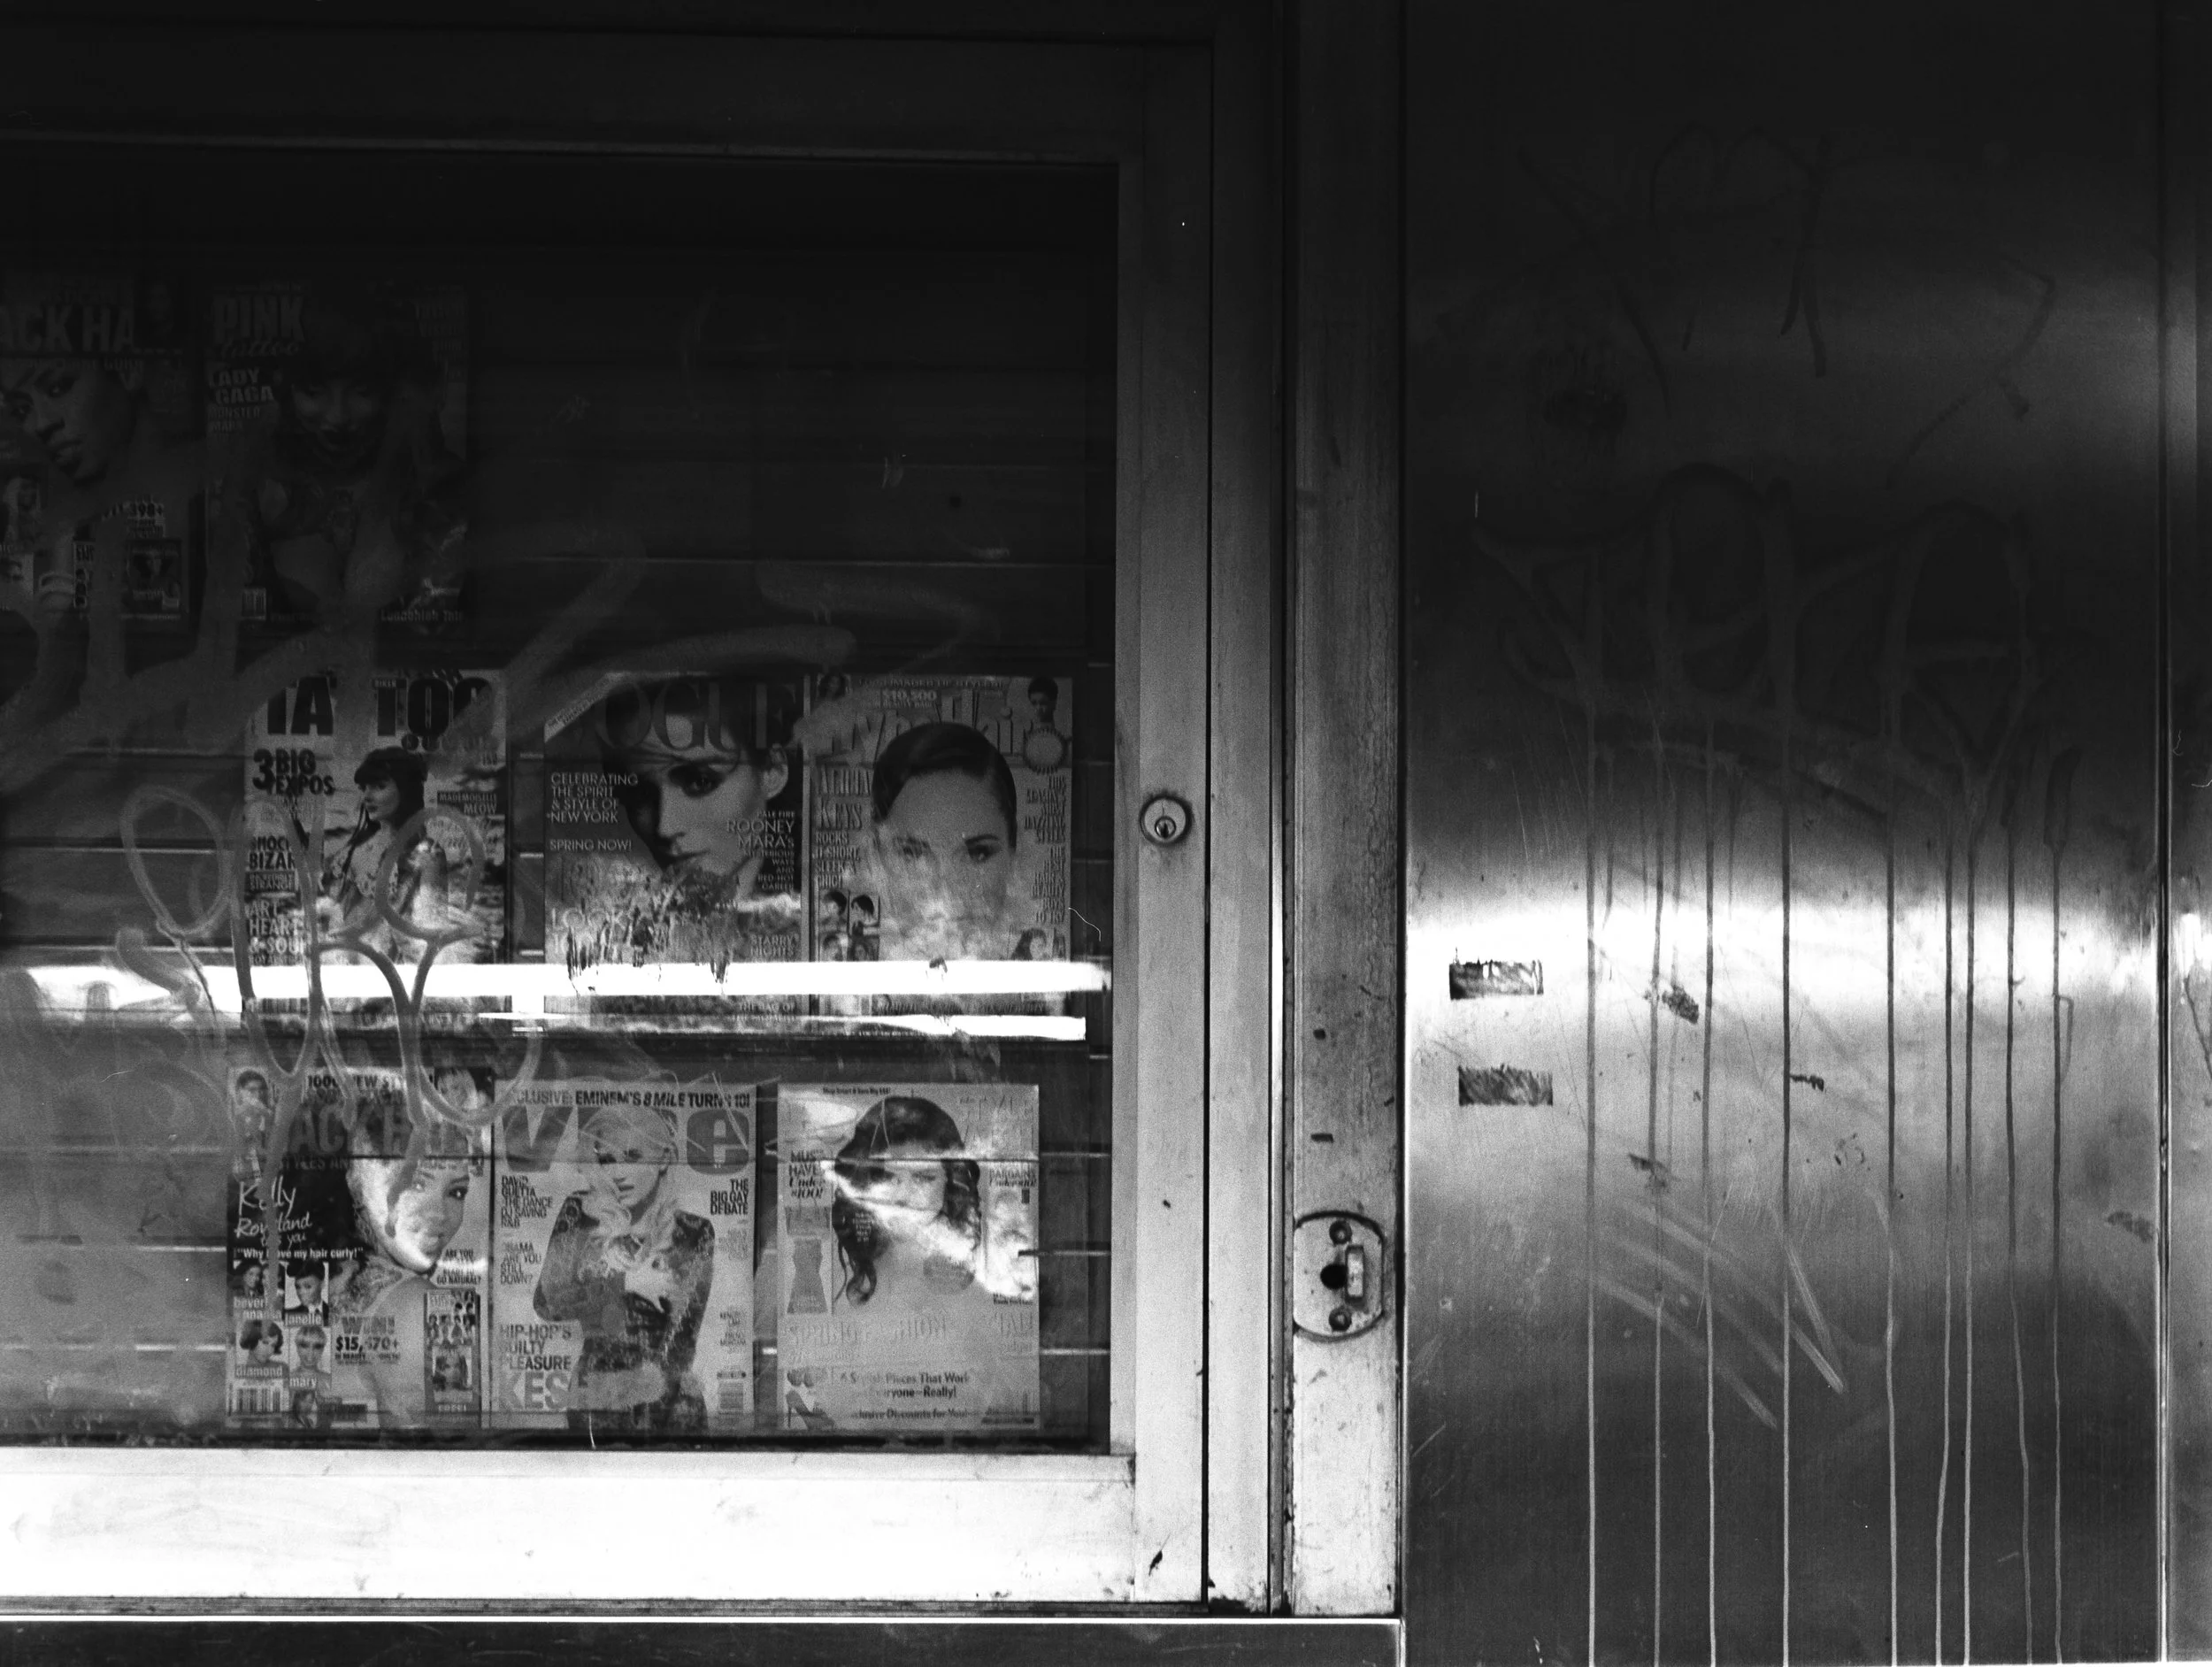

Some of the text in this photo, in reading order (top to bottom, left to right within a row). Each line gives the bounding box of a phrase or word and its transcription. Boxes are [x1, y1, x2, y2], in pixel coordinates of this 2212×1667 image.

[212, 294, 305, 344] PINK
[207, 365, 260, 388] LADY
[215, 386, 275, 403] GAGA
[595, 681, 797, 750] OGUE
[549, 772, 639, 787] CELEBRATING
[551, 786, 615, 798] THE SPIRIT
[551, 798, 619, 811] & STYLE OF
[549, 811, 619, 824] NEW YORK
[726, 818, 795, 834] ROONEY
[549, 839, 633, 852] SPRING NOW!
[575, 1089, 641, 1107] EMINEM'S
[642, 1089, 653, 1107] 8
[730, 1178, 749, 1192] THE
[710, 1190, 749, 1204] BIG GAY
[710, 1202, 749, 1216] DEBATE
[294, 1249, 307, 1261] my
[310, 1248, 328, 1259] hair
[234, 1296, 268, 1310] bever
[509, 1340, 546, 1355] UILTY
[289, 1378, 318, 1391] mary
[919, 1371, 942, 1384] That
